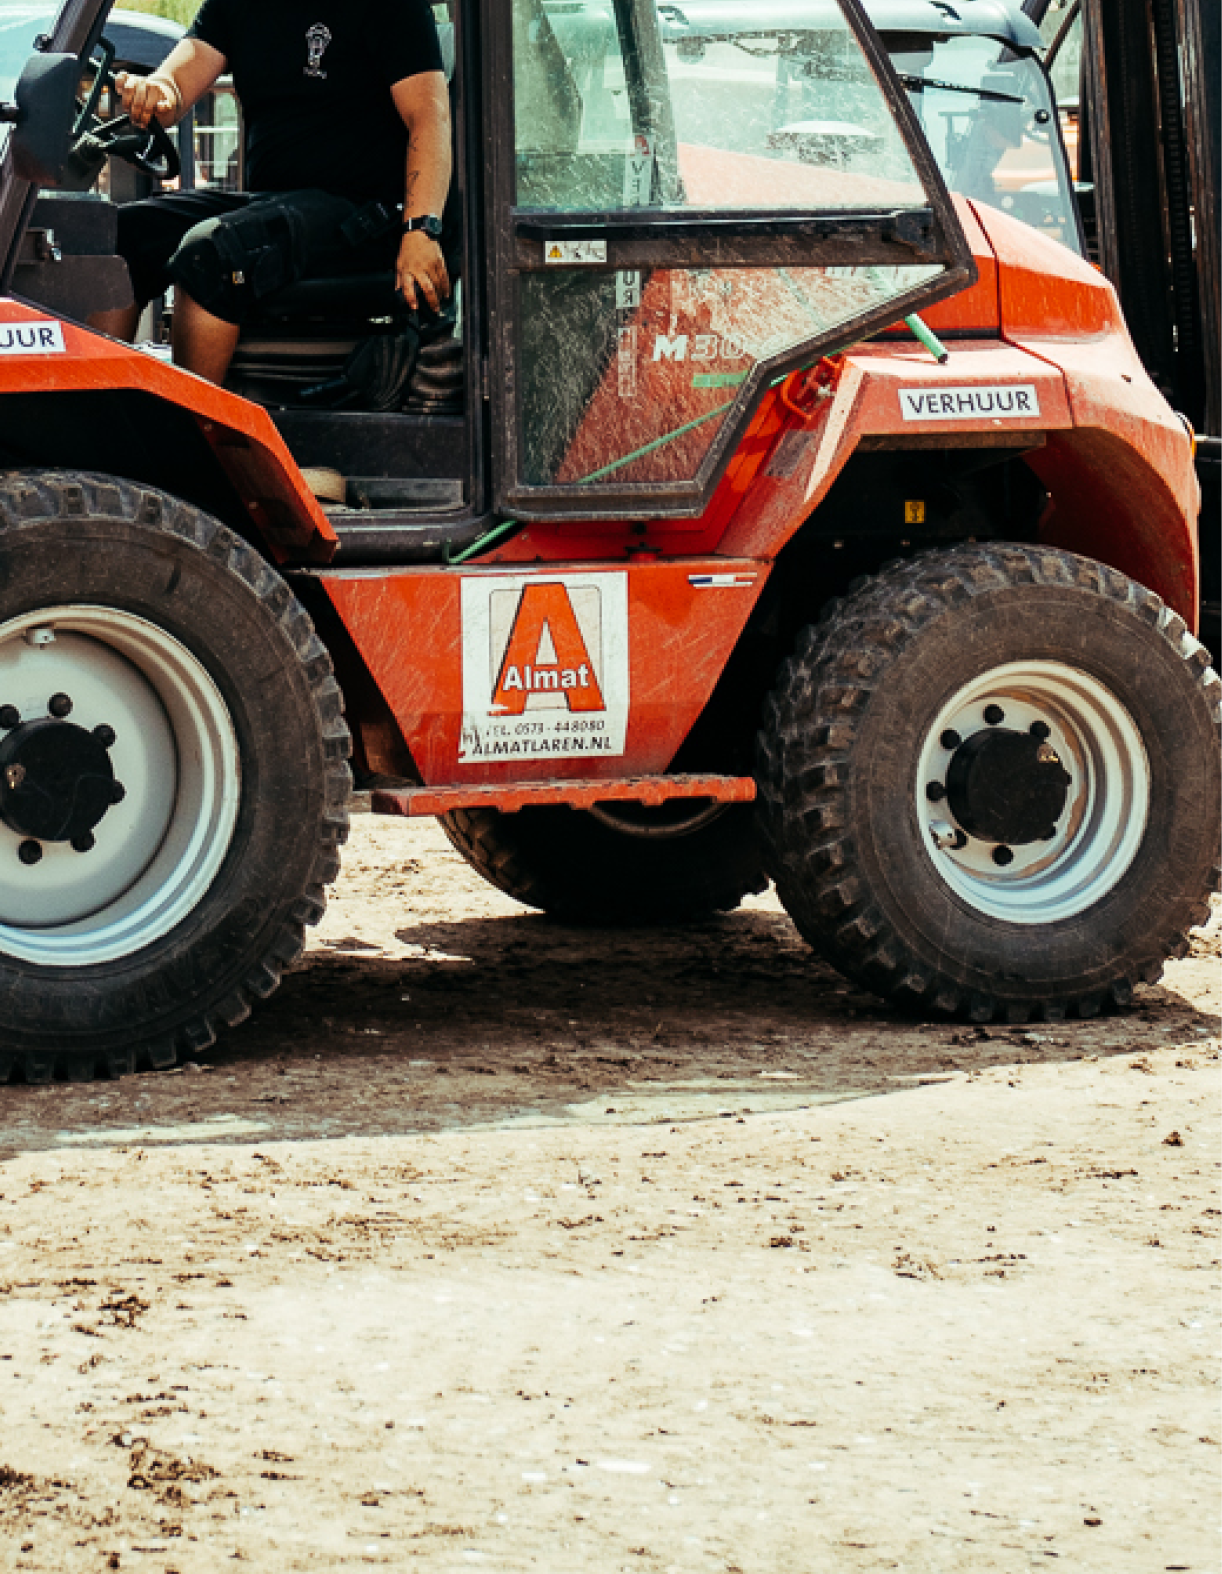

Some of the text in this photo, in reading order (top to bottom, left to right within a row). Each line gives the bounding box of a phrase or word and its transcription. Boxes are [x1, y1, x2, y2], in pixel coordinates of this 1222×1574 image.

[906, 391, 1032, 414] VERHUUR
[487, 581, 607, 717] A
[503, 663, 590, 691] Almat
[472, 736, 612, 756] ALMATLAREN.NL
